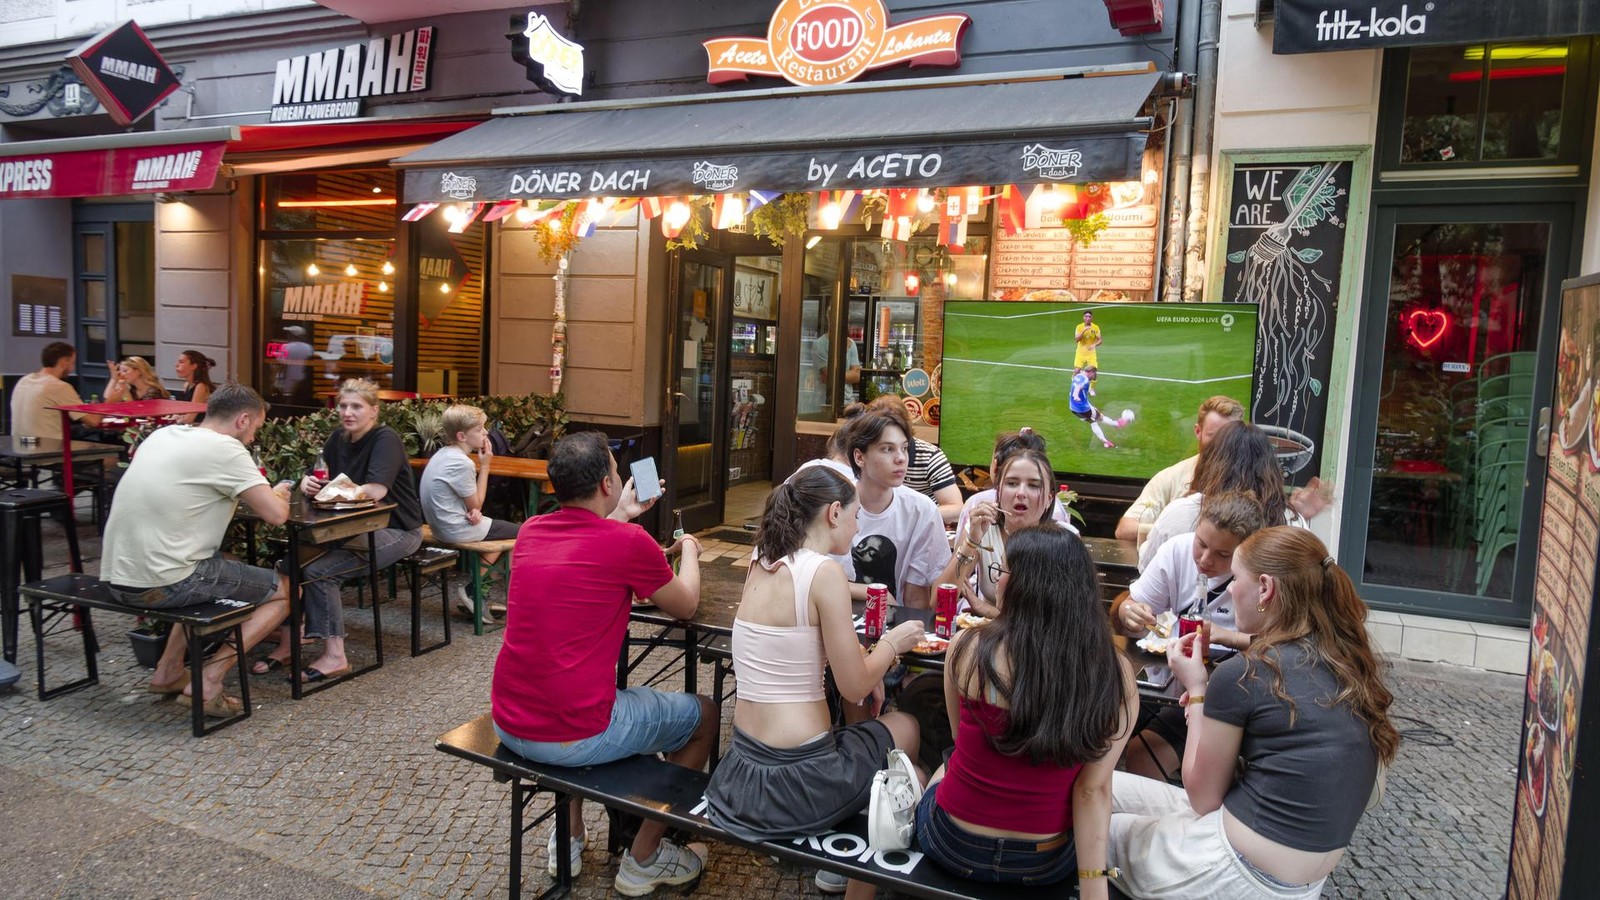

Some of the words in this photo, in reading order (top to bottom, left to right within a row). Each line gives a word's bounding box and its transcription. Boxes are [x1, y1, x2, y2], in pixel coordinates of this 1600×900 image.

[795, 17, 860, 51] FOOD
[1316, 4, 1426, 41] fritz-kola
[717, 43, 768, 66] Aceto
[777, 36, 876, 82] Restaurant
[880, 28, 952, 58] Lokanta
[101, 55, 158, 84] MMAAH
[272, 29, 414, 105] MMAAH
[271, 105, 304, 122] KOREAN
[304, 101, 359, 120] POWERFOOD
[134, 151, 198, 182] MMAAH
[807, 158, 838, 187] by
[847, 153, 942, 180] ACETO
[1023, 150, 1082, 171] DÖNER
[510, 169, 581, 194] DÖNER
[589, 169, 650, 192] DACH
[1245, 170, 1283, 201] WE
[283, 282, 364, 315] MMAAH
[1293, 297, 1303, 333] HAPPY
[1256, 366, 1267, 400] VEGAN
